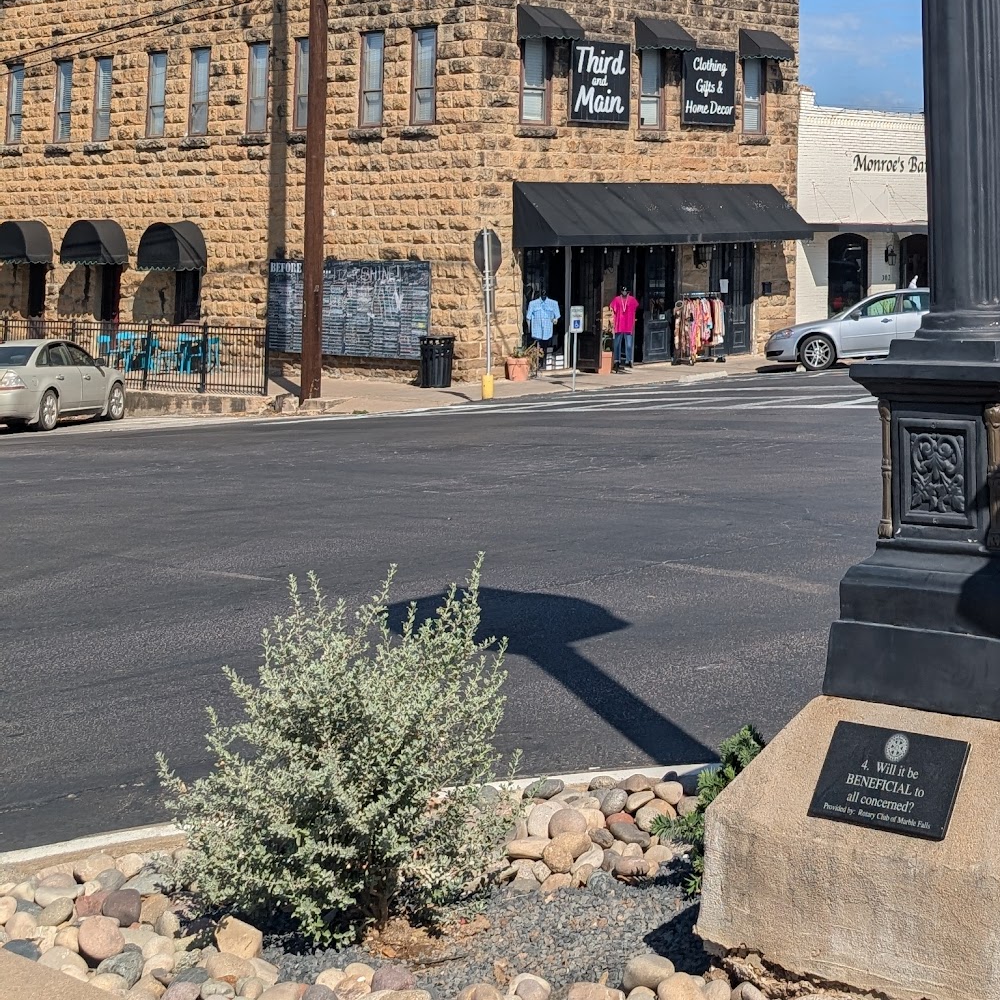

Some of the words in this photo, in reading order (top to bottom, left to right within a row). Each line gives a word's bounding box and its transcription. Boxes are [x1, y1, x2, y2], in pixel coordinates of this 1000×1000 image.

[576, 46, 626, 75] Third
[693, 57, 727, 77] Clothing
[592, 75, 608, 87] and
[696, 78, 715, 97] Gifts
[717, 83, 723, 94] &
[574, 85, 624, 114] Main
[685, 100, 709, 114] Home
[710, 101, 734, 115] Decor
[853, 154, 905, 173] Monroe's
[270, 262, 303, 273] BEFORE
[861, 759, 869, 771] 4.
[876, 762, 896, 775] Will
[897, 764, 905, 777] it
[907, 766, 919, 780] be
[846, 773, 912, 796] BENEFICIAL
[914, 787, 925, 798] to
[846, 791, 858, 803] all
[860, 795, 914, 813] concerned?
[823, 802, 846, 814] Provided
[846, 805, 856, 816] by:
[858, 809, 876, 821] Rotary
[876, 811, 889, 821] Club
[890, 813, 897, 823] of
[897, 816, 916, 828] Marble
[917, 819, 931, 830] Falls
